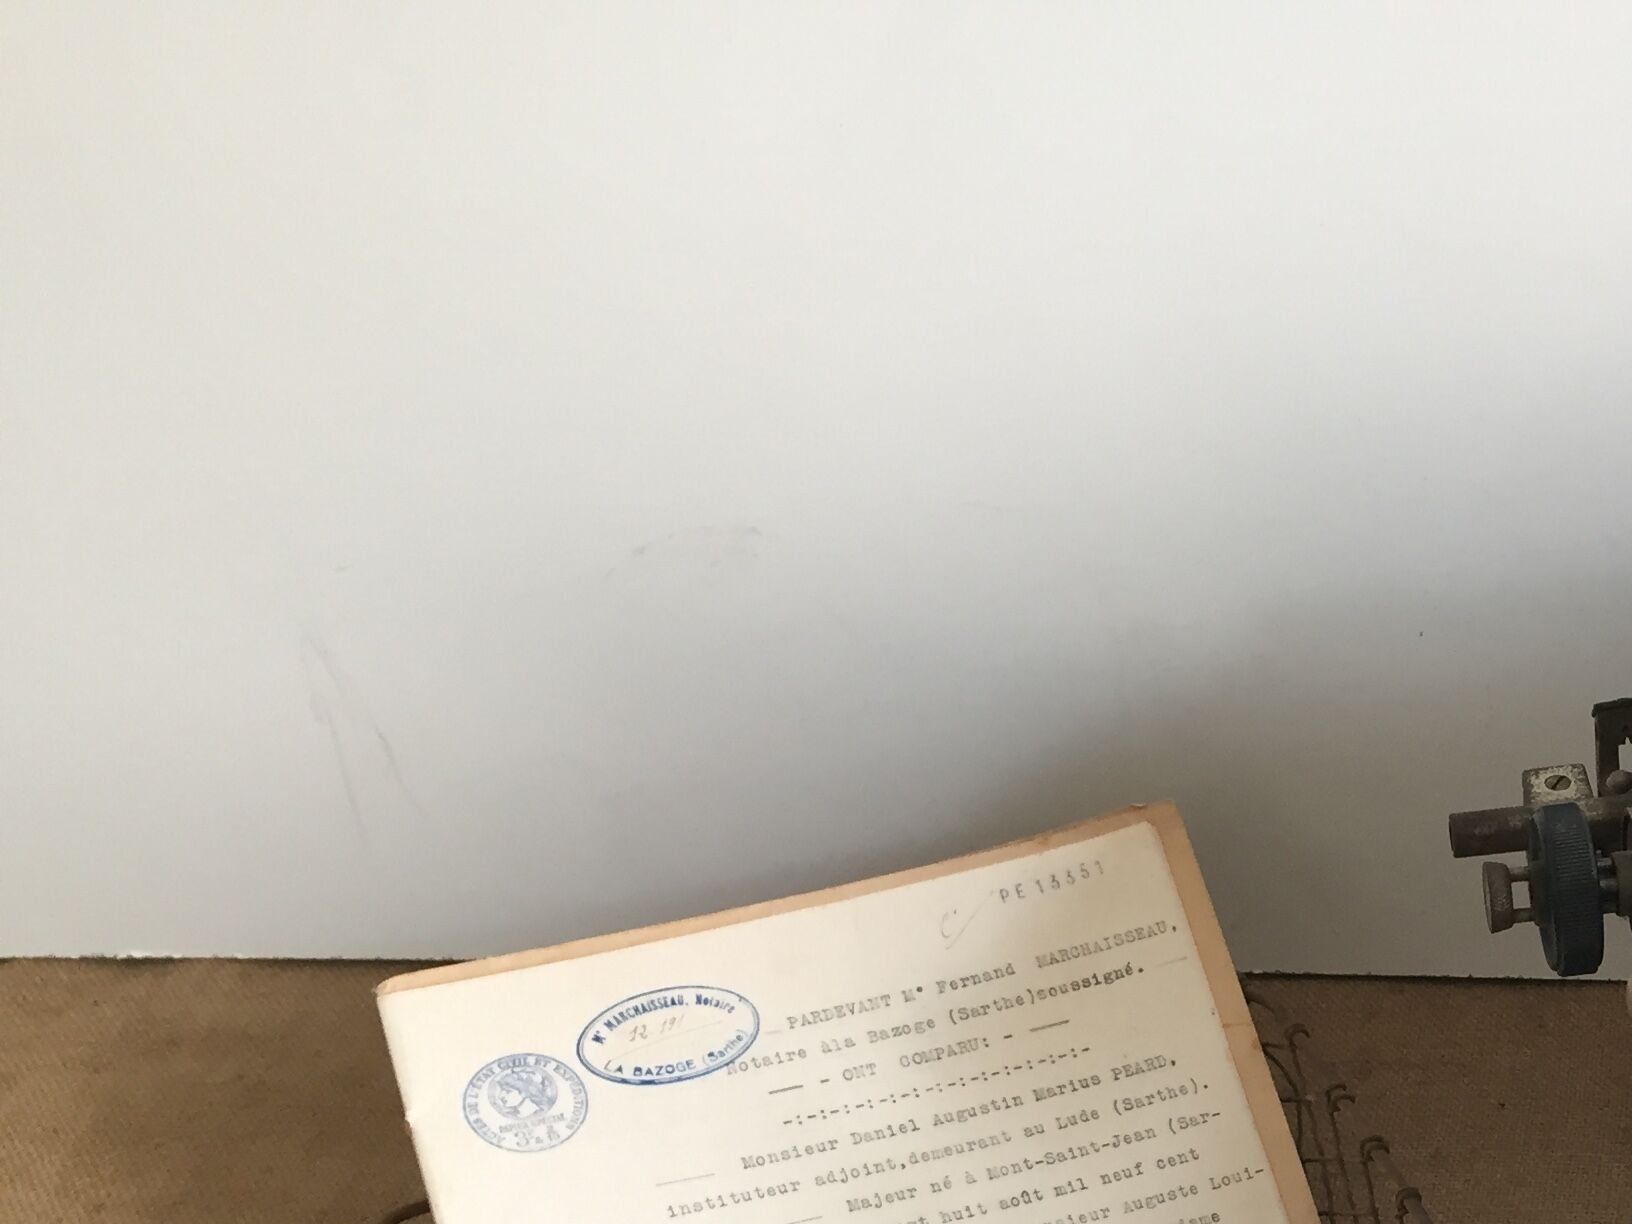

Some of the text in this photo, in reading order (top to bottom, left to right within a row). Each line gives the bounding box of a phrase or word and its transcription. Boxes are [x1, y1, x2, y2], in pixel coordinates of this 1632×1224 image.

[999, 882, 1027, 904] PE
[695, 993, 736, 1014] Notaire
[785, 993, 892, 1031] PARDEVANT
[935, 962, 1017, 995] Fernand
[603, 1059, 624, 1075] LA
[633, 1059, 697, 1077] BAZOGE
[720, 1048, 808, 1076] Notaire
[866, 1018, 936, 1044] Bazoge
[841, 1062, 877, 1082] ONT
[740, 1054, 1177, 1171] Monsieur Daniel Augustin Marius PEARD,
[666, 1180, 801, 1219] instituteur
[1023, 1123, 1046, 1139] au
[1054, 1108, 1101, 1131] Lude
[1112, 1077, 1209, 1117] (Sarthe).
[845, 1111, 1221, 1213] Majeur né à Mont-Saint-Jean (Sar-
[938, 1202, 988, 1224] huit
[998, 1187, 1045, 1211] août
[1052, 1177, 1089, 1199] mil
[1098, 1161, 1145, 1186] neuf
[1155, 1147, 1200, 1170] cent
[1123, 1184, 1199, 1215] Auguste
